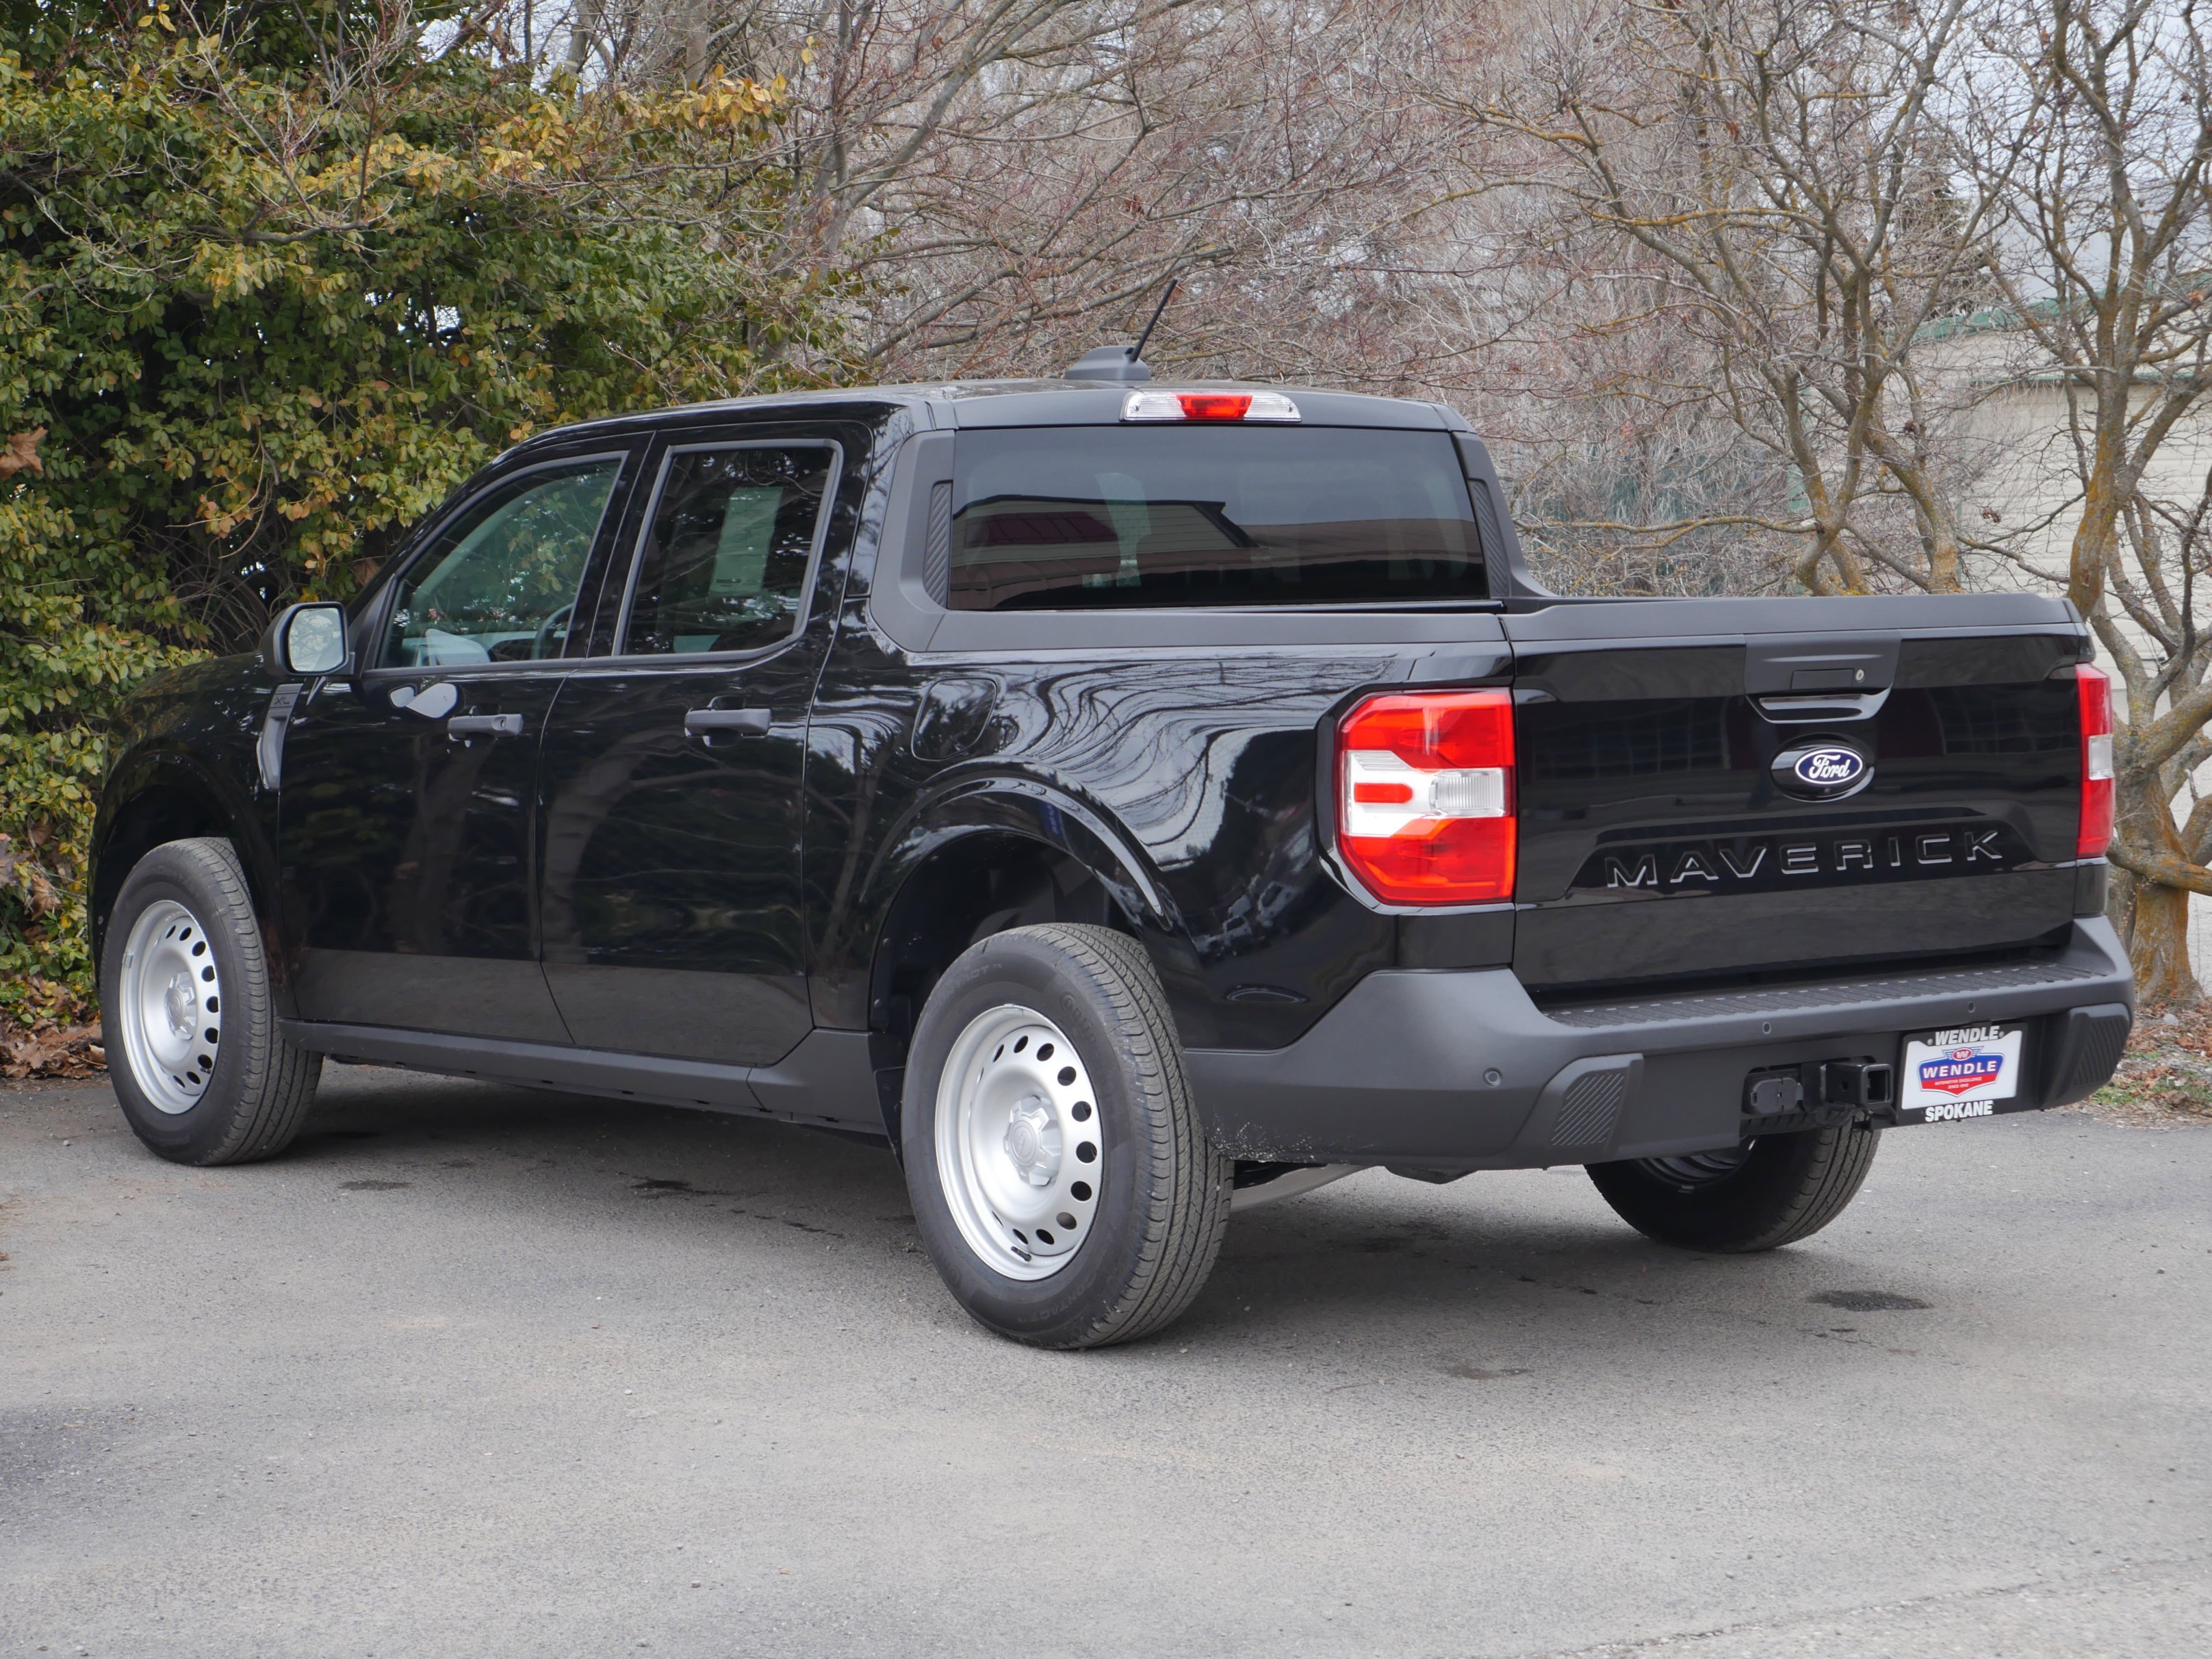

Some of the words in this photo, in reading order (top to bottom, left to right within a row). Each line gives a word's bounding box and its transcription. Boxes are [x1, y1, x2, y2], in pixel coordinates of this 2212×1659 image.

[274, 695, 290, 706] XL
[1808, 754, 1851, 779] Ford
[1605, 830, 2003, 888] MAVERICK
[1935, 1025, 2000, 1046] WENDLE
[1956, 1051, 1969, 1059] W
[1923, 1061, 1997, 1079] WENDLE
[1925, 1101, 1993, 1122] SPOKANE
